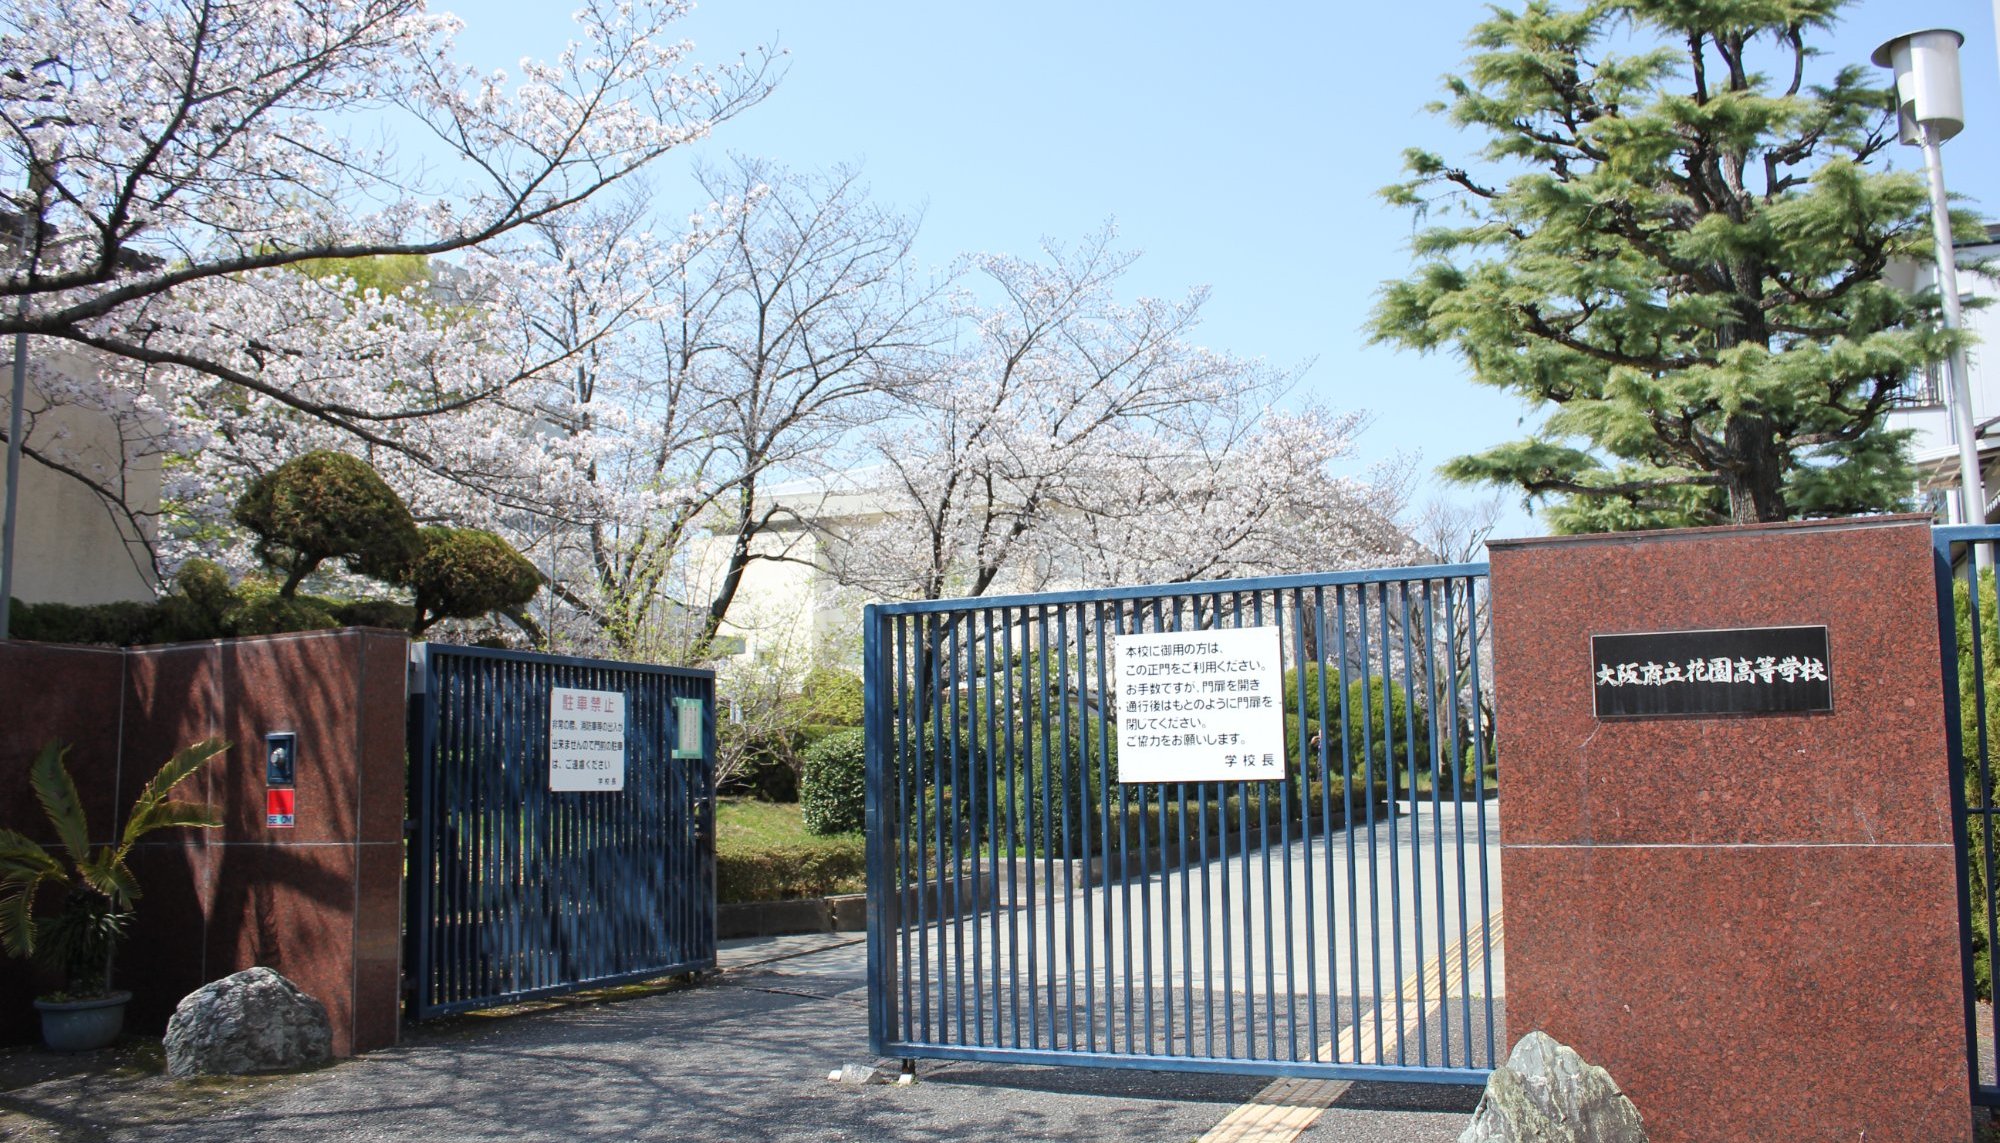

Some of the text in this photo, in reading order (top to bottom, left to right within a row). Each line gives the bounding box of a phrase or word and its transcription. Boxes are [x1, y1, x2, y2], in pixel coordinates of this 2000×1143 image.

[1126, 642, 1223, 658] 本校に御用の方は、
[1126, 660, 1265, 676] この正門をご利用ください。
[1596, 656, 1828, 687] 大阪府立花園高等学校
[562, 694, 614, 713] 駐車禁止
[1126, 696, 1272, 713] 通行後はもとのように門扉を
[1126, 718, 1206, 731] 閉じてください。
[1126, 732, 1245, 747] ご協力をお願いします。
[1225, 753, 1274, 767] 学校長
